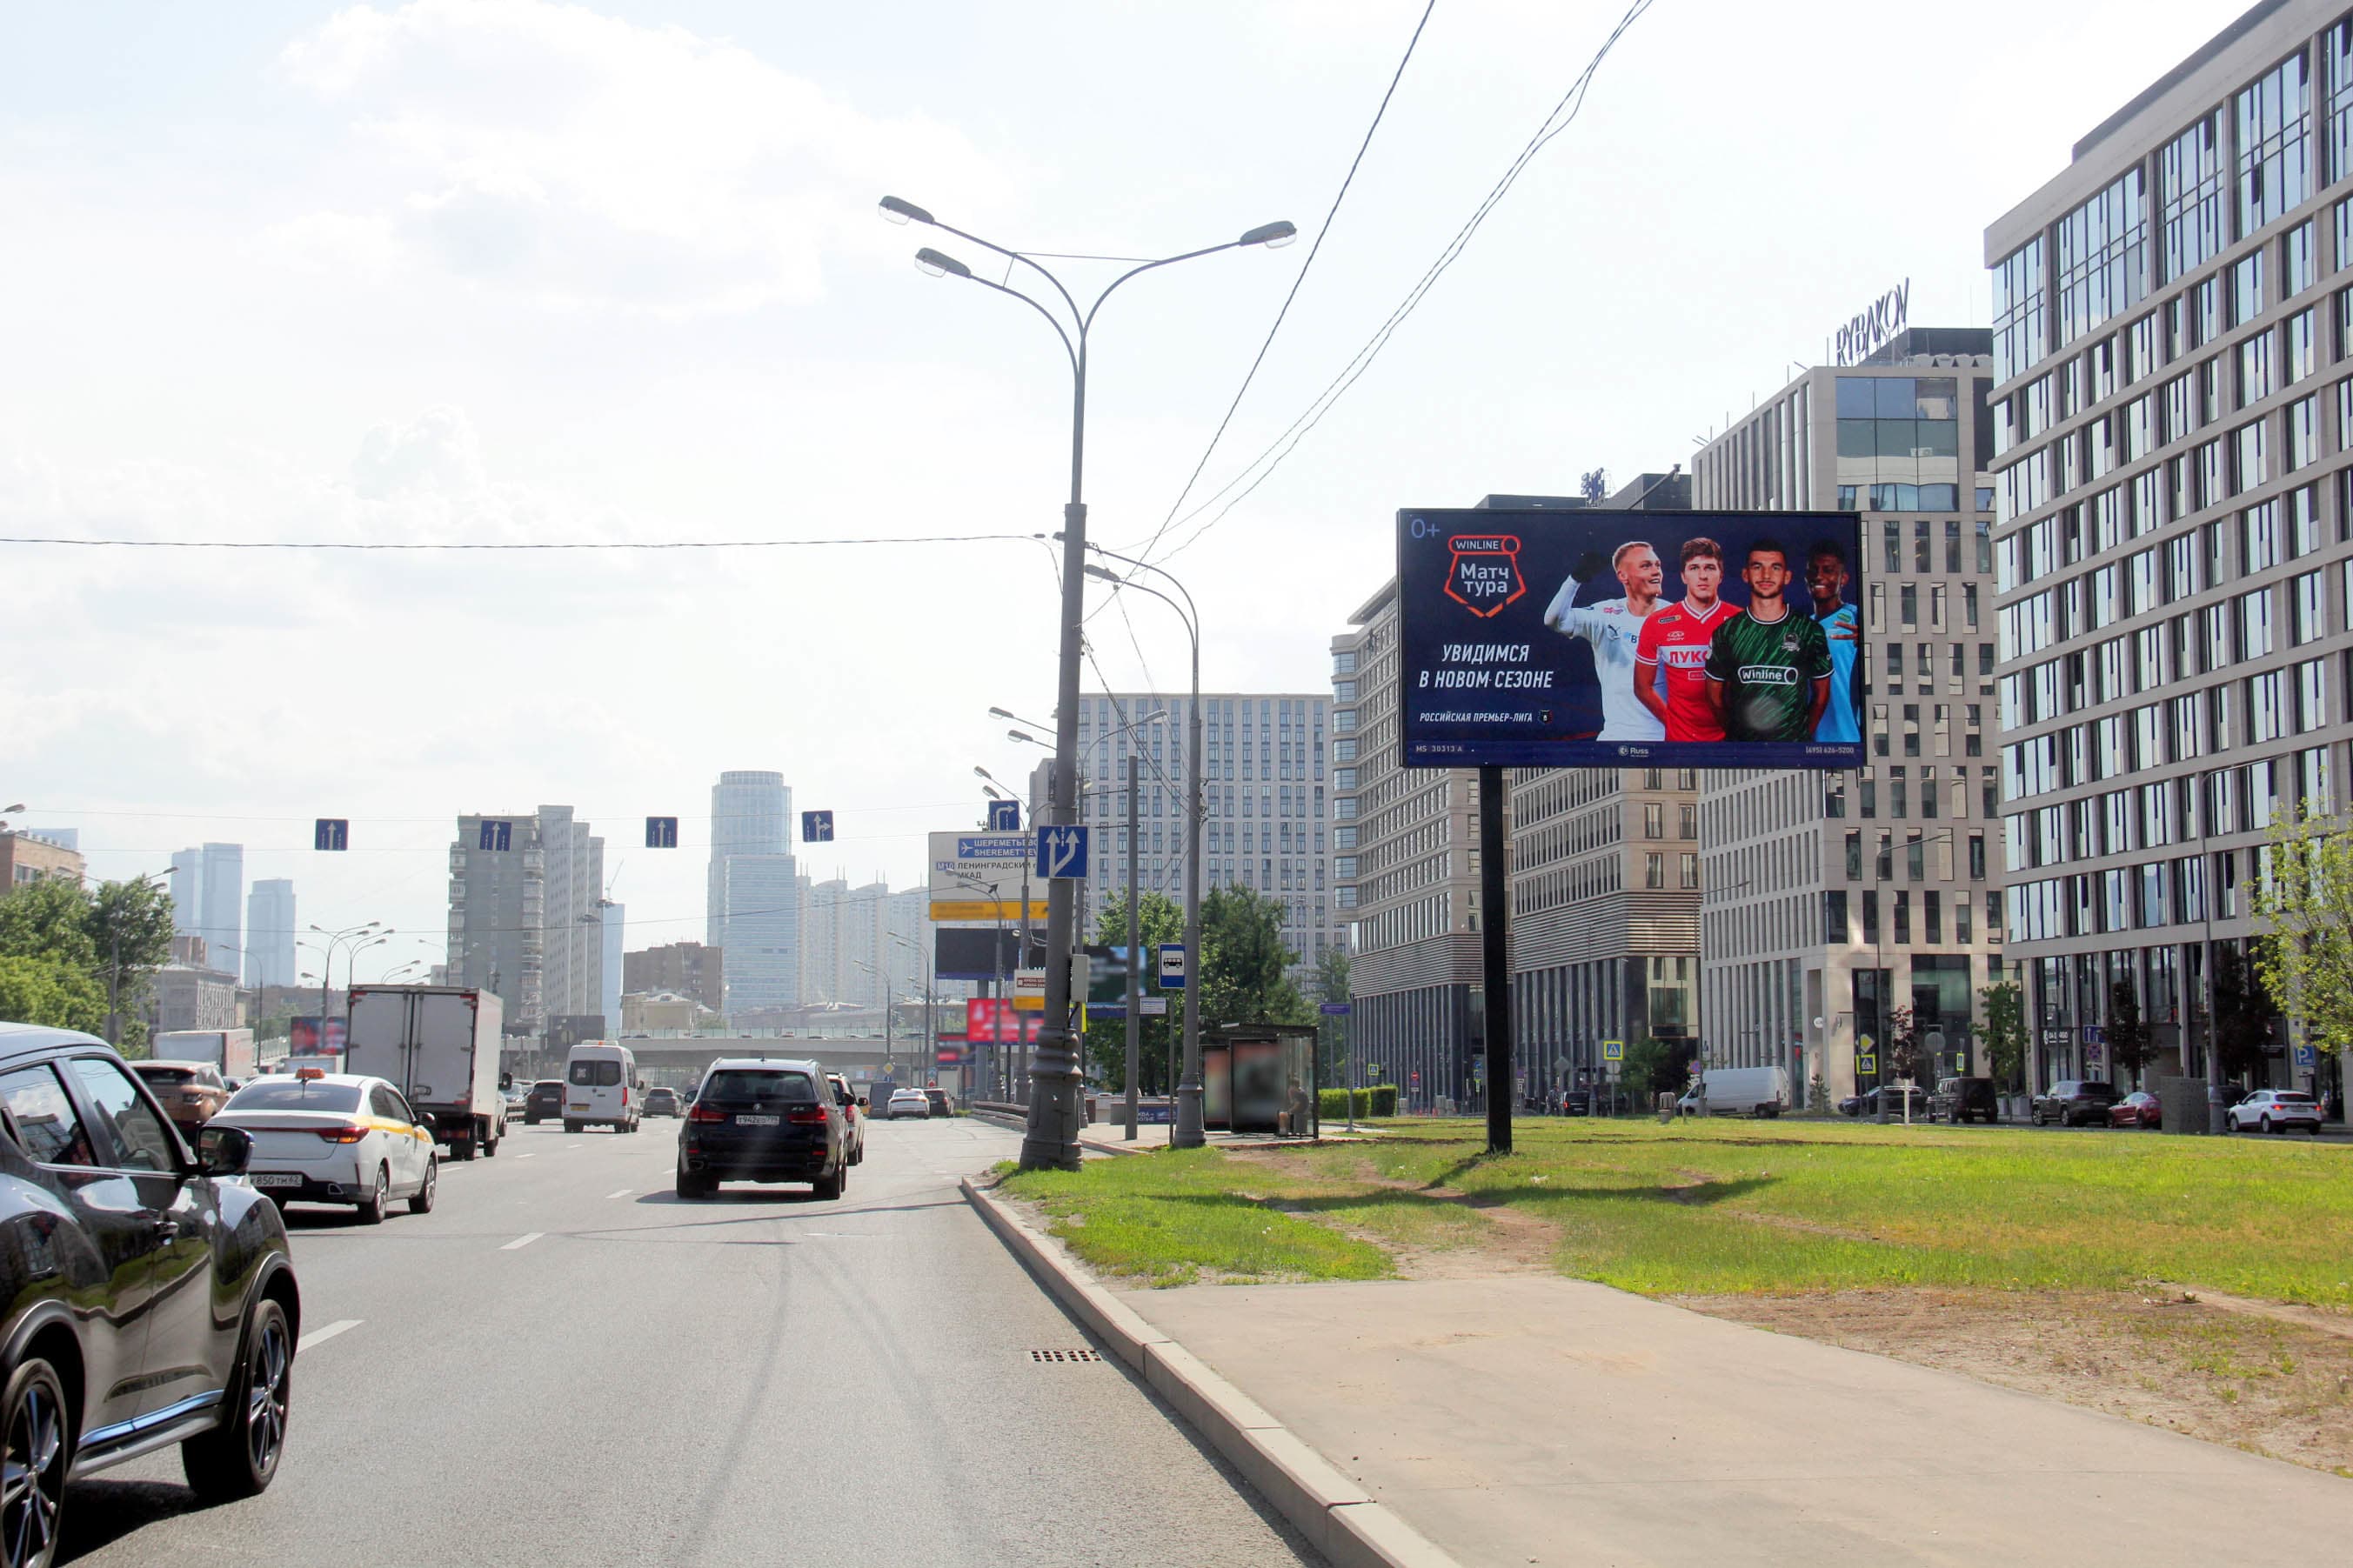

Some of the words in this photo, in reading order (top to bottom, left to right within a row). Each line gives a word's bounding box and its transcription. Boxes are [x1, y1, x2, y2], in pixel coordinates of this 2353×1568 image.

[1837, 277, 1909, 365] RYBAKOV
[1411, 518, 1441, 538] 0+
[1455, 540, 1500, 550] WINLINE
[1461, 563, 1509, 579] Матч
[1464, 581, 1507, 597] тура
[1441, 644, 1530, 664] УВИДИМСЯ
[1419, 671, 1429, 688] В
[1434, 671, 1489, 688] НОВОМ
[1494, 671, 1554, 688] СЕЗОНЕ
[1741, 669, 1782, 680] Winline
[1420, 711, 1471, 723] РОССИЙСКАЯ
[1474, 712, 1533, 723] ПРЕМЬЕР-ЛИГА
